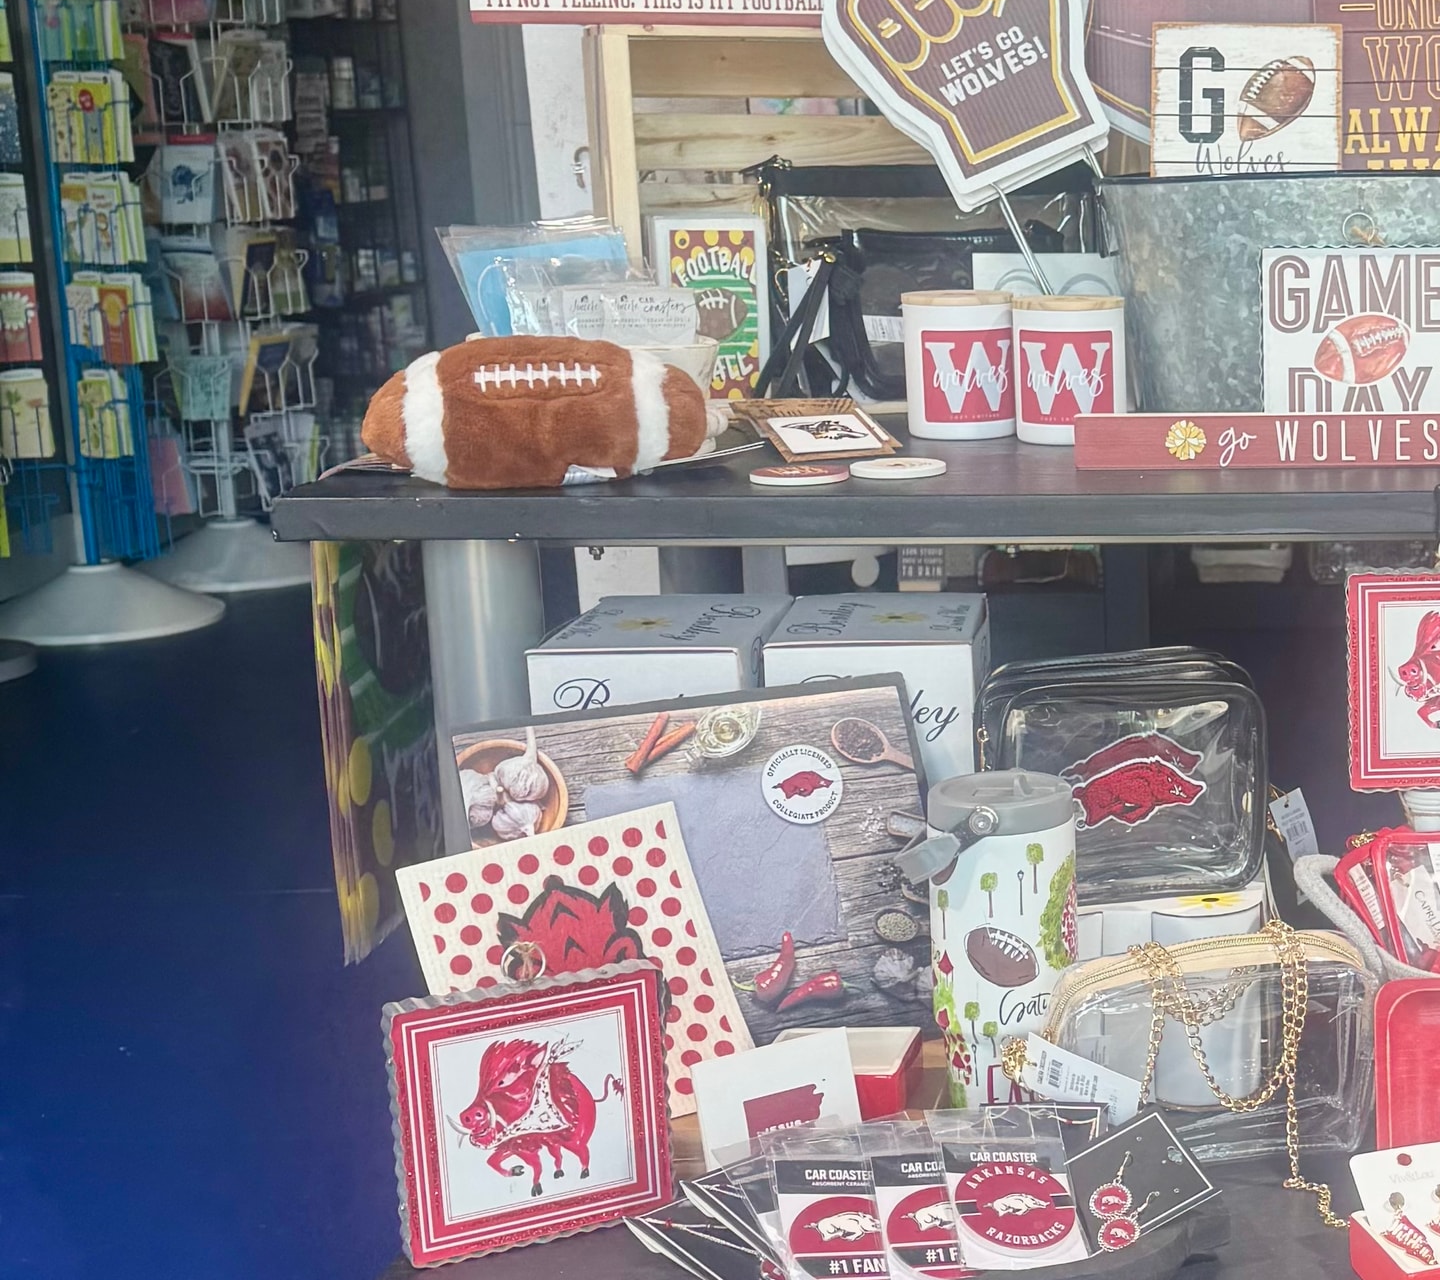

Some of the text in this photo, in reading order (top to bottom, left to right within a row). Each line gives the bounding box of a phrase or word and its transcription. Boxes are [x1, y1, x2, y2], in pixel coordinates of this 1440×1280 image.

[939, 25, 1025, 80] LET'S GO
[939, 36, 1050, 108] WOLVES!
[675, 245, 757, 287] FOOTBALL
[924, 339, 1011, 414] W
[932, 363, 1009, 394] wolves
[1021, 341, 1111, 416] W
[1027, 365, 1107, 397] wolves
[1218, 425, 1258, 468] go
[1275, 419, 1439, 462] WOLVES
[800, 748, 832, 769] LICENSED
[772, 790, 839, 820] COLLEGIATE PRODUCT
[901, 1162, 923, 1173] CAR
[969, 1151, 1038, 1163] CAR COASTER
[805, 1169, 827, 1180] CAR
[966, 1165, 1049, 1191] ARKANSAS
[986, 1221, 1067, 1248] RAZORBACKS
[829, 1258, 888, 1274] #1 FAN
[926, 1248, 945, 1263] #1
